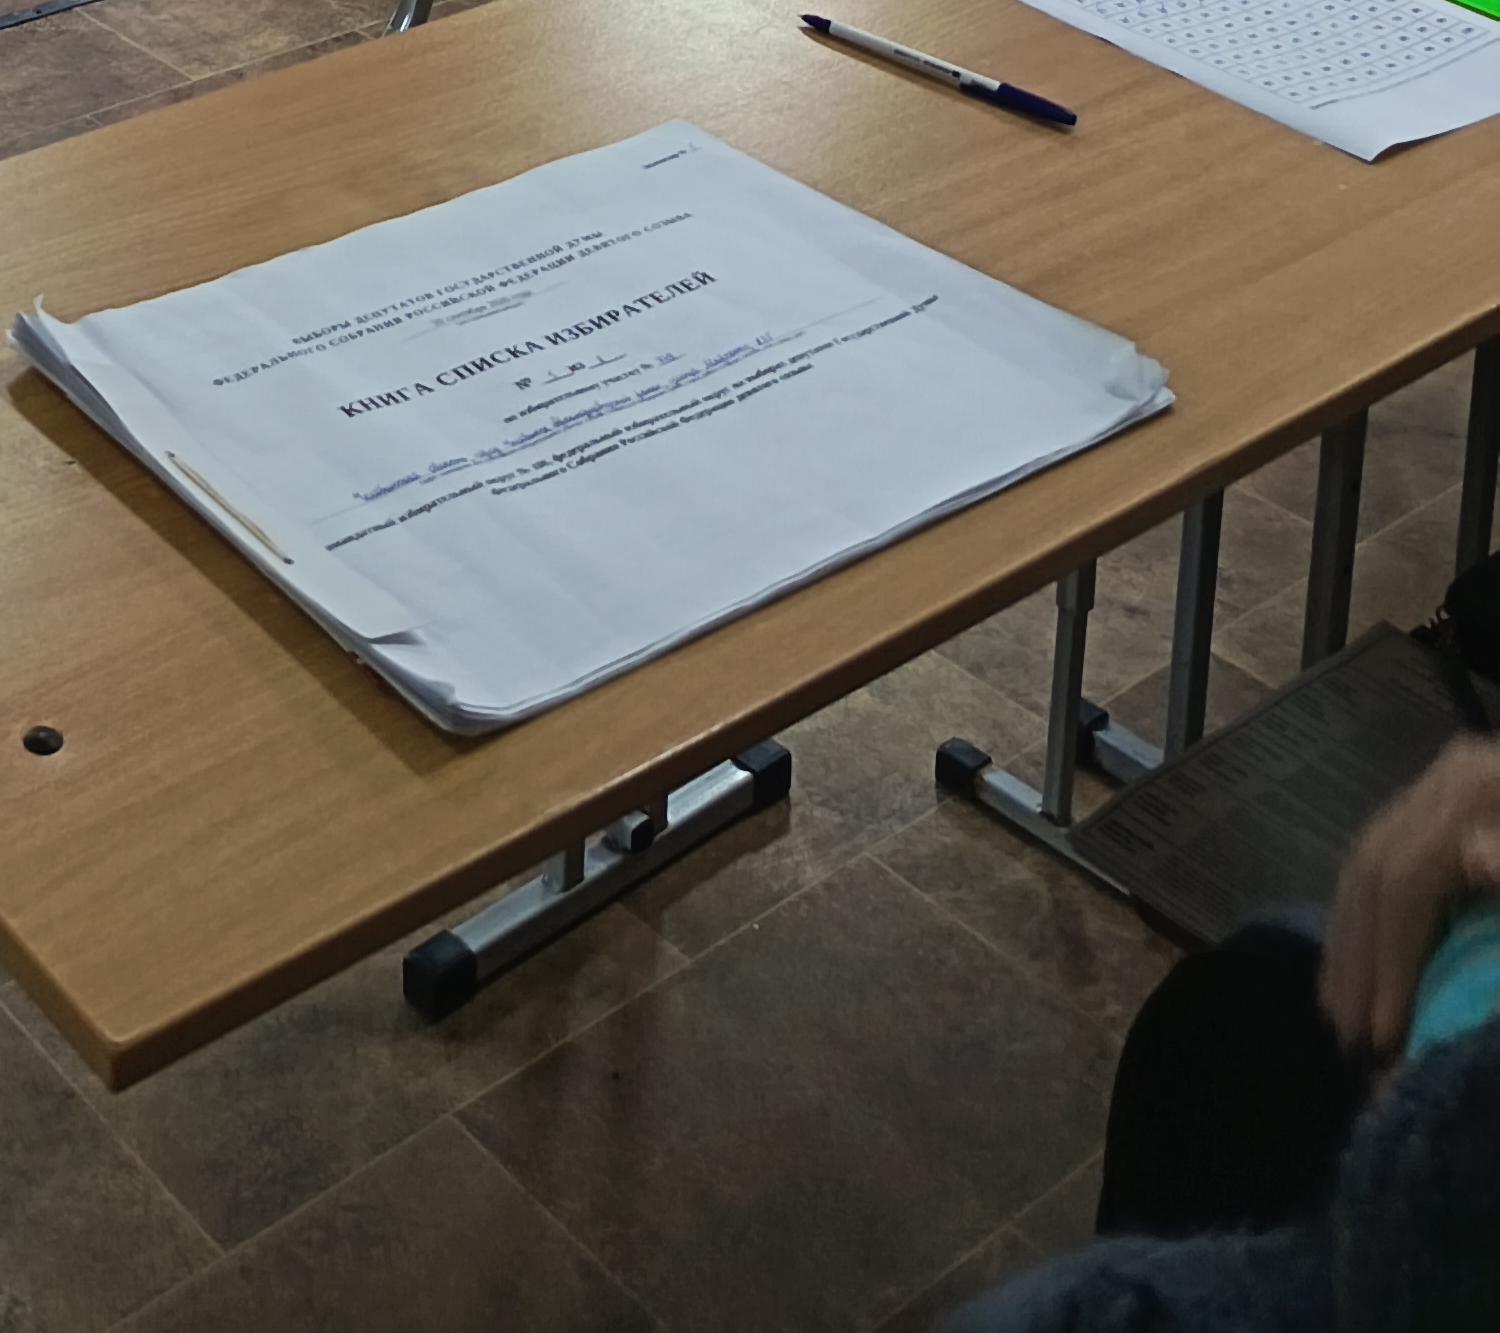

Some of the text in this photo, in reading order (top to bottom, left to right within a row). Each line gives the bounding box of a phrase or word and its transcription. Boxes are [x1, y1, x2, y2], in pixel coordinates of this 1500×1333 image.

[338, 380, 435, 419] КНИГА
[435, 340, 546, 387] СПИСКА
[544, 269, 719, 347] ИЗБИРАТЕЛЕЙ
[357, 291, 434, 326] ДЕПУТАТОВ
